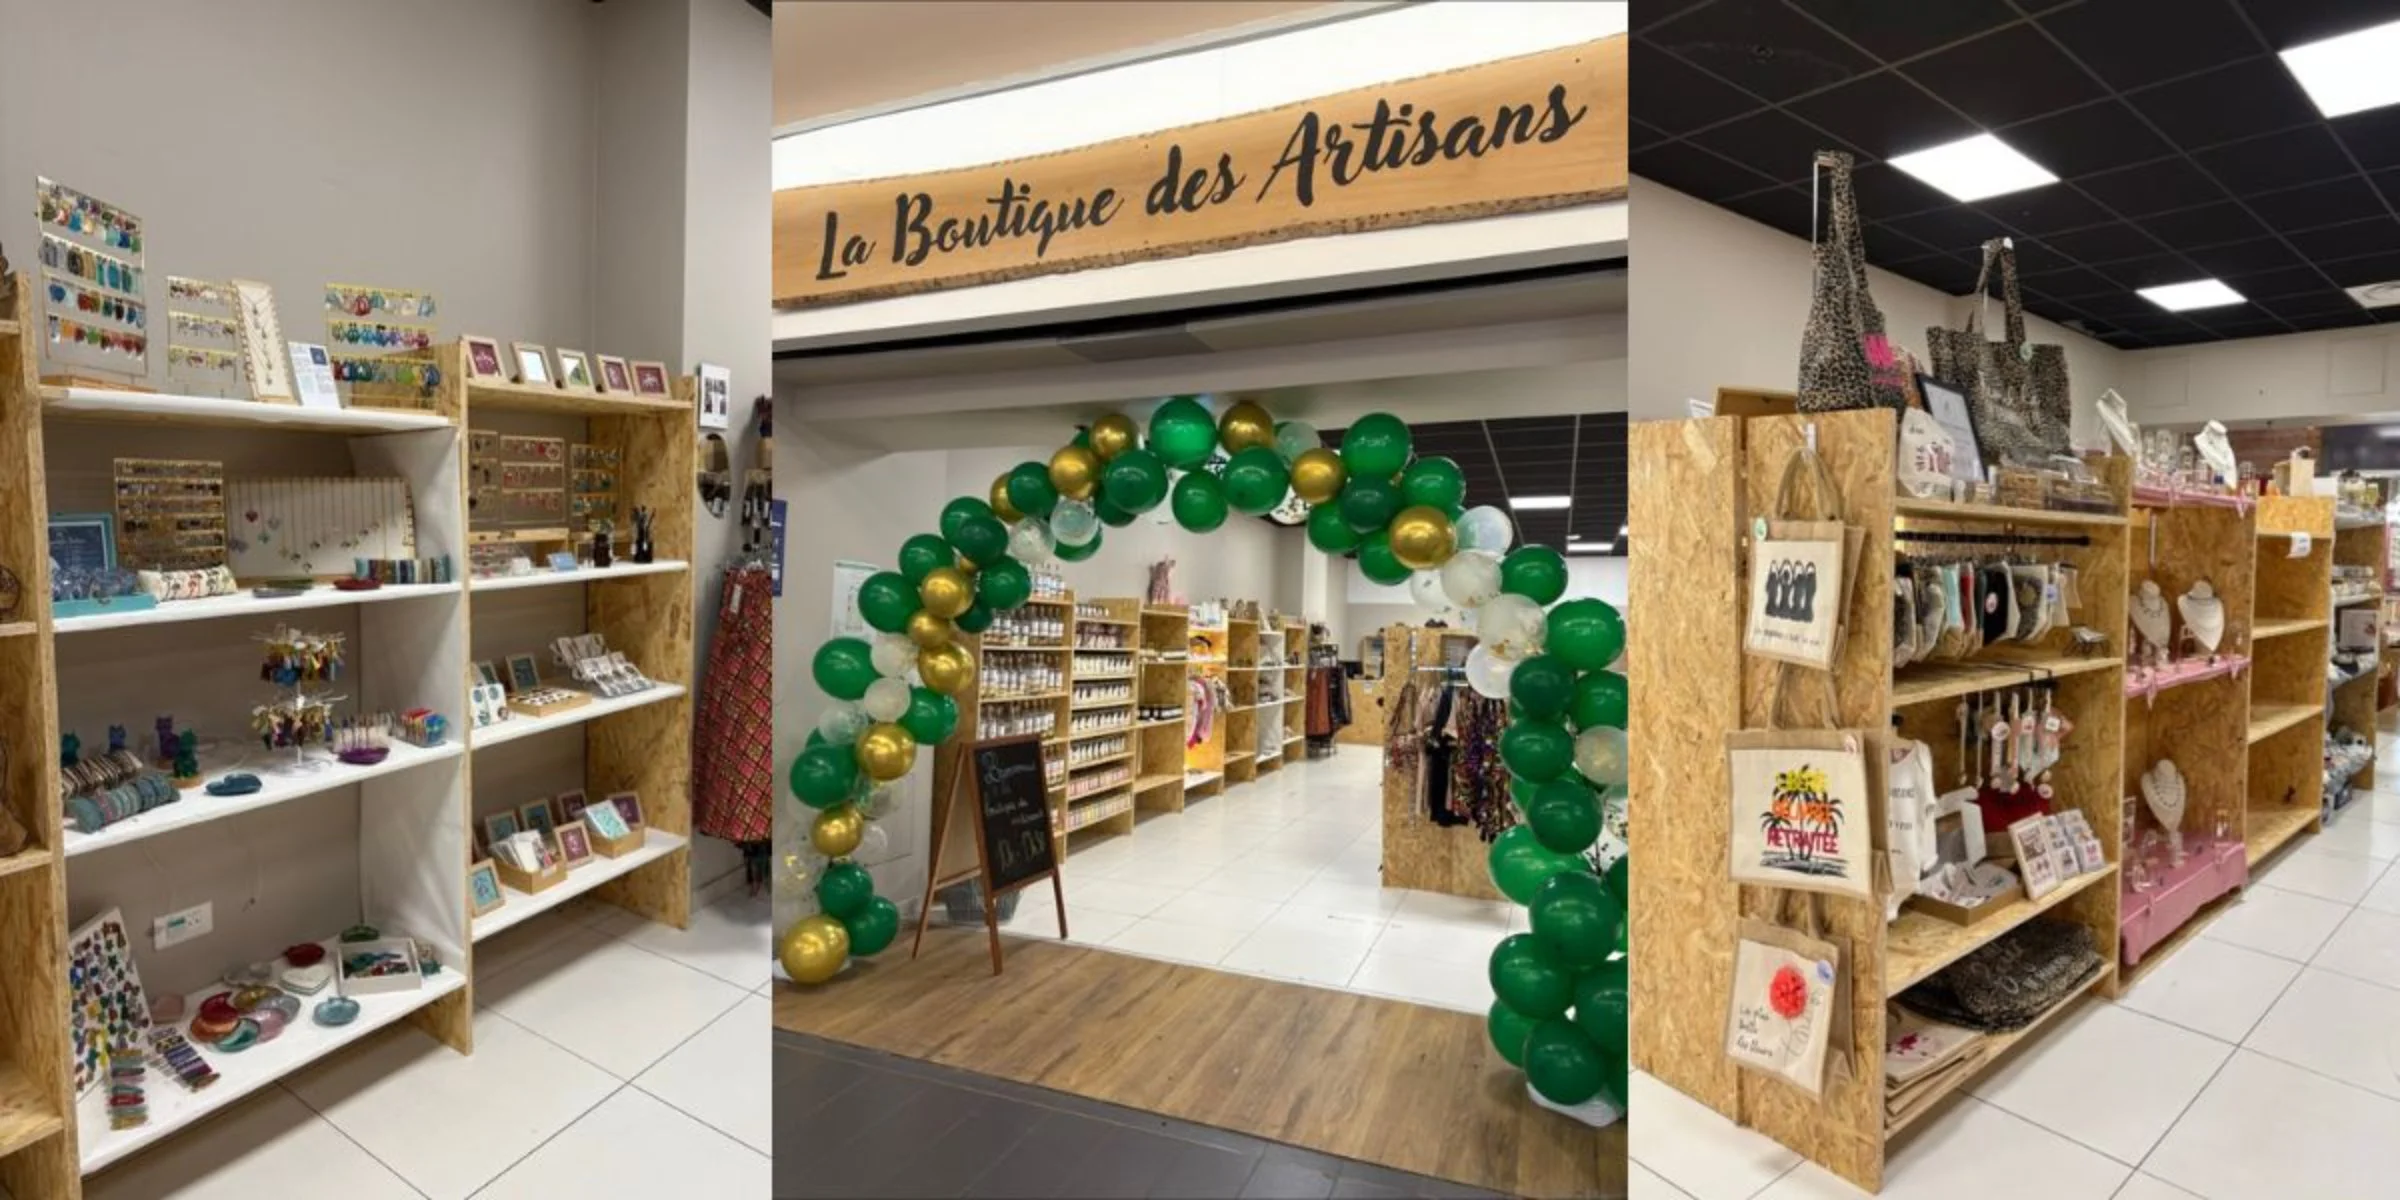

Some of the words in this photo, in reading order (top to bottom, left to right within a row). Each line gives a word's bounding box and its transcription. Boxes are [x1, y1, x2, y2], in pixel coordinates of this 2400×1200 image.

[814, 211, 876, 281] La
[892, 179, 1123, 267] Boutique
[1145, 146, 1246, 215] des
[1256, 84, 1588, 206] Artisans
